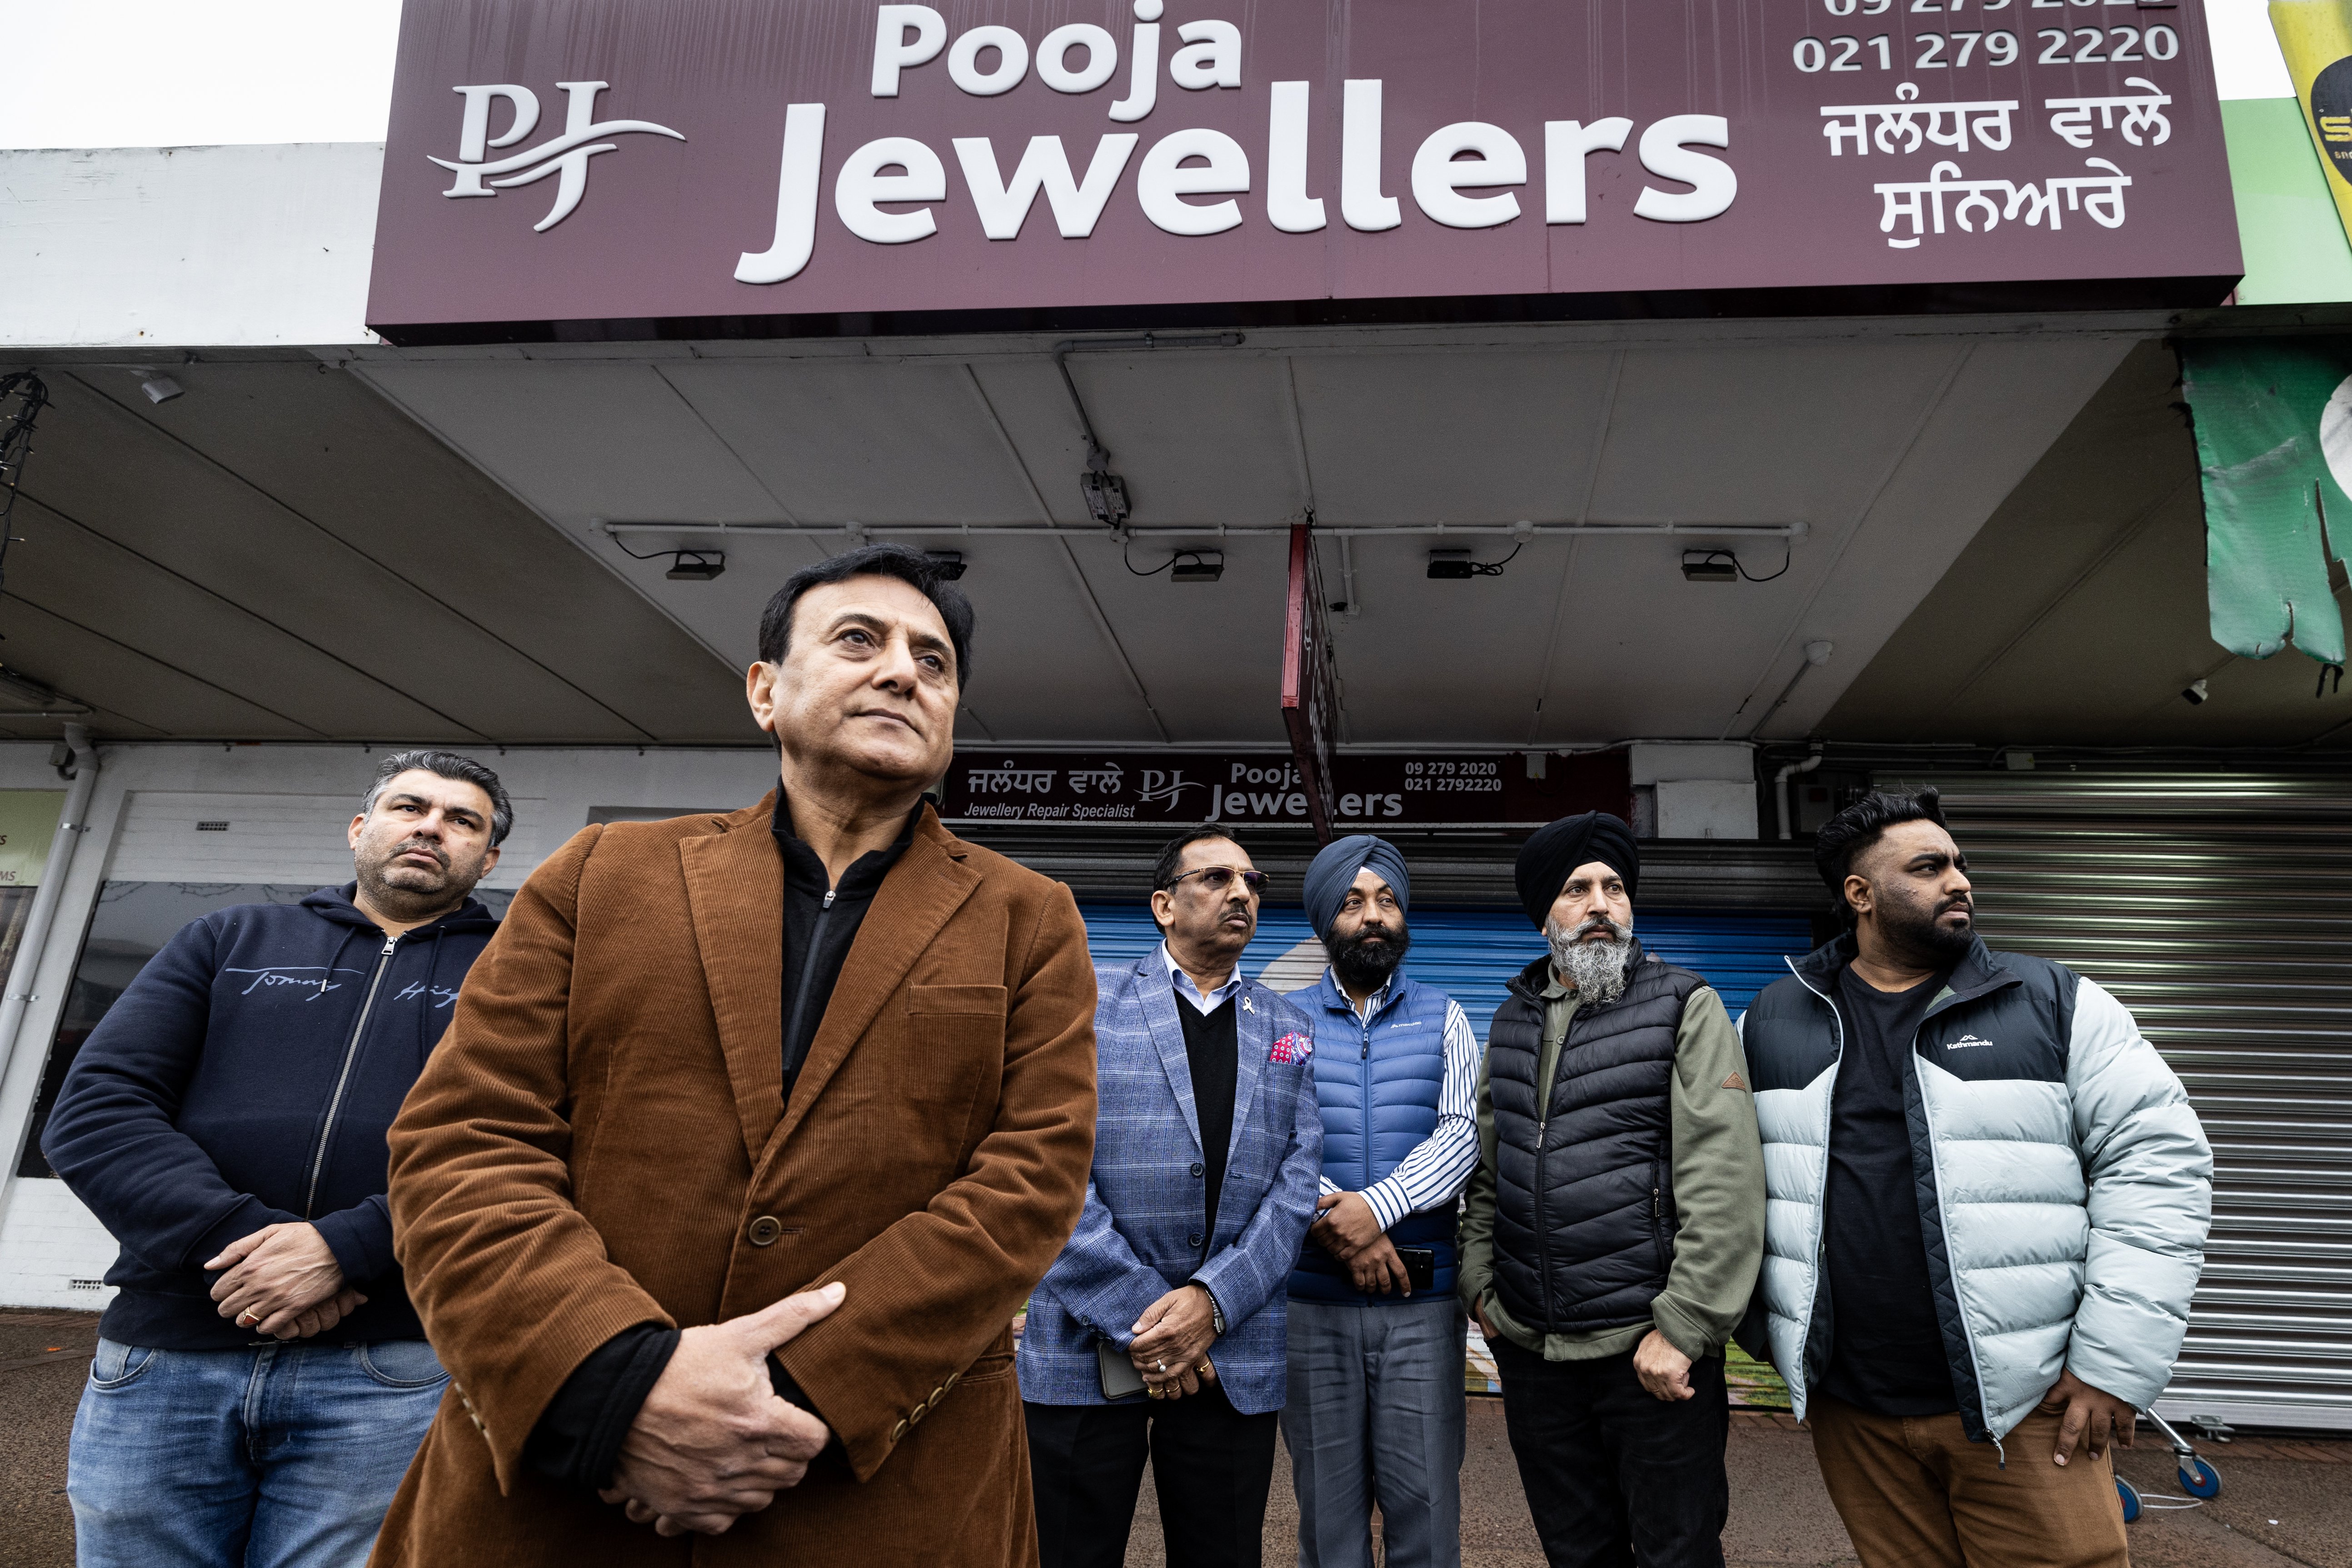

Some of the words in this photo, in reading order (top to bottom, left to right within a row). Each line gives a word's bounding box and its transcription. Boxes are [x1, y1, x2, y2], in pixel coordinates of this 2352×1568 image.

[871, 0, 1243, 122] Pooja
[1793, 34, 1892, 72] 021
[1915, 29, 2019, 69] 279
[2037, 25, 2179, 65] 2220
[1820, 82, 2019, 156] ਜਲੰਧਰ
[2045, 77, 2172, 148] ਵਾਲੇ
[426, 81, 687, 232] PJ
[734, 79, 1738, 284] Jewellers
[1874, 157, 2132, 249] ਸੁਨਿਆਰੇ
[968, 760, 1057, 794] ਜਲੰਧਰ
[1069, 762, 1124, 794] ਵਾਲੇ
[1405, 762, 1423, 774] 09
[1428, 762, 1455, 774] 279
[1460, 762, 1497, 775] 2020
[1405, 778, 1431, 790] 021
[1437, 779, 1502, 791] 2792220
[964, 803, 1025, 819] Jewellery
[1027, 803, 1070, 819] Repair
[1072, 804, 1135, 820] Specialist
[1133, 770, 1207, 812] PJ
[1204, 784, 1403, 822] Jeweers
[1947, 1039, 1993, 1050] Kathmandu
